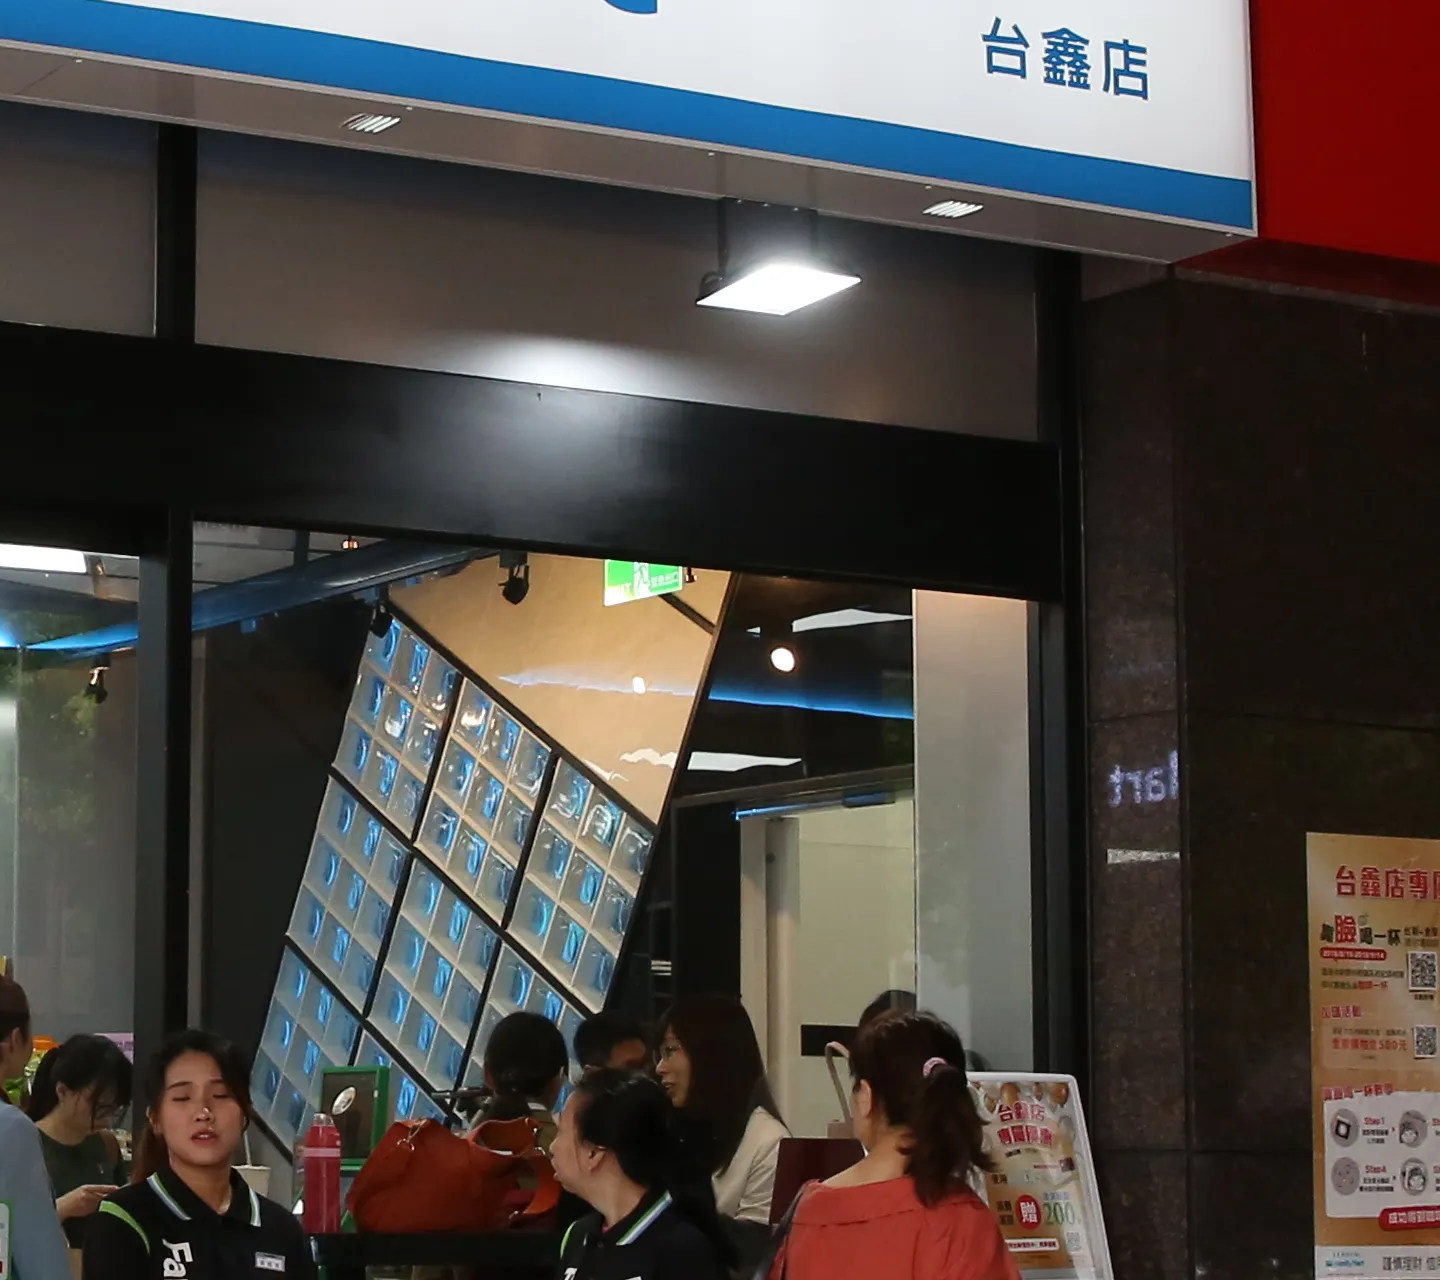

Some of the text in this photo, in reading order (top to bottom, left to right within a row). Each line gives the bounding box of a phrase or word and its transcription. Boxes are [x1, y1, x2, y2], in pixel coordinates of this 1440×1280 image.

[979, 17, 1150, 101] 台鑫店
[999, 1100, 1046, 1122] 台鑫店
[1019, 1200, 1039, 1224] 贈
[1042, 1201, 1075, 1226] 200
